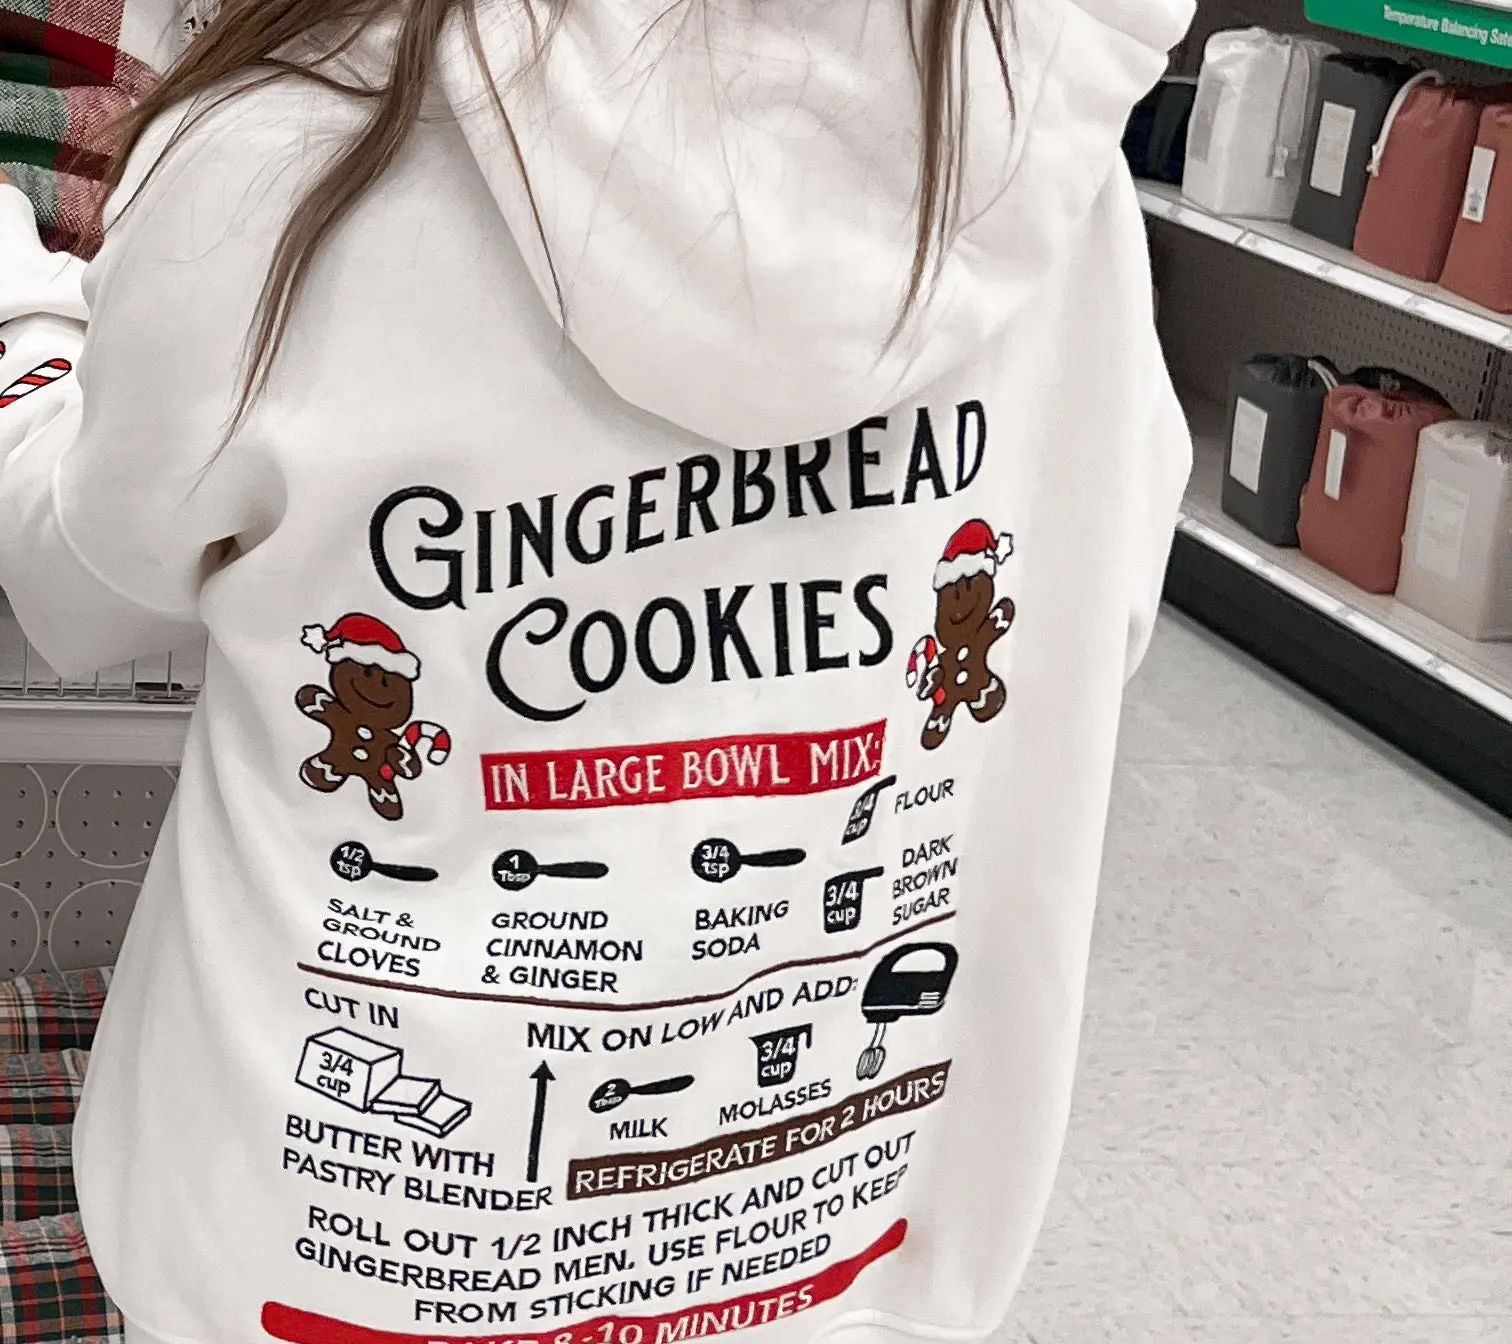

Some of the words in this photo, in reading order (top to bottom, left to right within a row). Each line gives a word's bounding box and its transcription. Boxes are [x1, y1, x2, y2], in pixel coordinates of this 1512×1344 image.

[1383, 4, 1439, 32] Temperature
[1440, 16, 1488, 46] Balancing
[369, 399, 987, 611] GINGERBREAD
[488, 573, 894, 722] COOKIES
[489, 762, 530, 804] IN
[546, 754, 665, 802] LARGE
[681, 742, 791, 791] BOWL
[894, 778, 955, 815] FLOUR
[340, 845, 366, 863] 1/2
[509, 855, 520, 870] 1
[701, 844, 731, 861] 3/4
[902, 834, 954, 868] DARK
[336, 860, 362, 879] tsp
[701, 859, 730, 880] tsp
[892, 857, 959, 900] BROWN
[826, 880, 860, 907] 3/4
[892, 887, 951, 926] SUGAR
[327, 897, 392, 925] SALT
[395, 912, 415, 928] &
[491, 910, 609, 930] GROUND
[694, 899, 790, 931] BAKING
[826, 906, 857, 926] cup
[322, 917, 441, 952] GROUND
[485, 938, 644, 962] CINNAMON
[691, 932, 761, 961] SODA
[317, 940, 421, 978] CLOVES
[481, 964, 500, 985] &
[509, 965, 619, 994] GINGER
[304, 987, 361, 1019] CUT
[369, 1002, 400, 1029] IN
[527, 1021, 592, 1053] MIX
[601, 1024, 653, 1052] ON
[661, 1009, 727, 1044] LOW
[727, 988, 784, 1025] AND
[792, 975, 859, 1007] ADD:
[318, 1050, 354, 1077] 3/4
[761, 1036, 796, 1061] 3/4
[316, 1074, 351, 1098] cup
[760, 1060, 793, 1083] cup
[605, 1083, 616, 1097] 2
[718, 1078, 833, 1126] MOLASSES
[574, 1136, 778, 1194] REFRIGERATE
[786, 1118, 835, 1156] FOR
[841, 1106, 855, 1128] 2
[861, 1071, 947, 1120] HOURS
[609, 1117, 668, 1140] MILK
[285, 1113, 402, 1164] BUTTER
[412, 1140, 495, 1178] WITH
[282, 1147, 396, 1196] PASTRY
[404, 1175, 554, 1212] BLENDER
[308, 1205, 391, 1247] ROLL
[404, 1228, 479, 1259] OUT
[491, 1233, 541, 1261] 1/2
[553, 1214, 632, 1253] INCH
[642, 1192, 735, 1234] THICK
[741, 1175, 804, 1215] AND
[811, 1152, 860, 1190] CUT
[864, 1129, 917, 1169] OUT
[294, 1236, 541, 1293] GINGERBREAD
[554, 1248, 635, 1285] MEN.
[648, 1235, 706, 1267] USE
[716, 1208, 807, 1255] FLOUR
[813, 1193, 845, 1224] TO
[852, 1162, 909, 1211] KEEP
[414, 1298, 517, 1324] FROM
[529, 1275, 676, 1320] STICKING
[687, 1267, 712, 1294] IF
[721, 1232, 832, 1286] NEEDED
